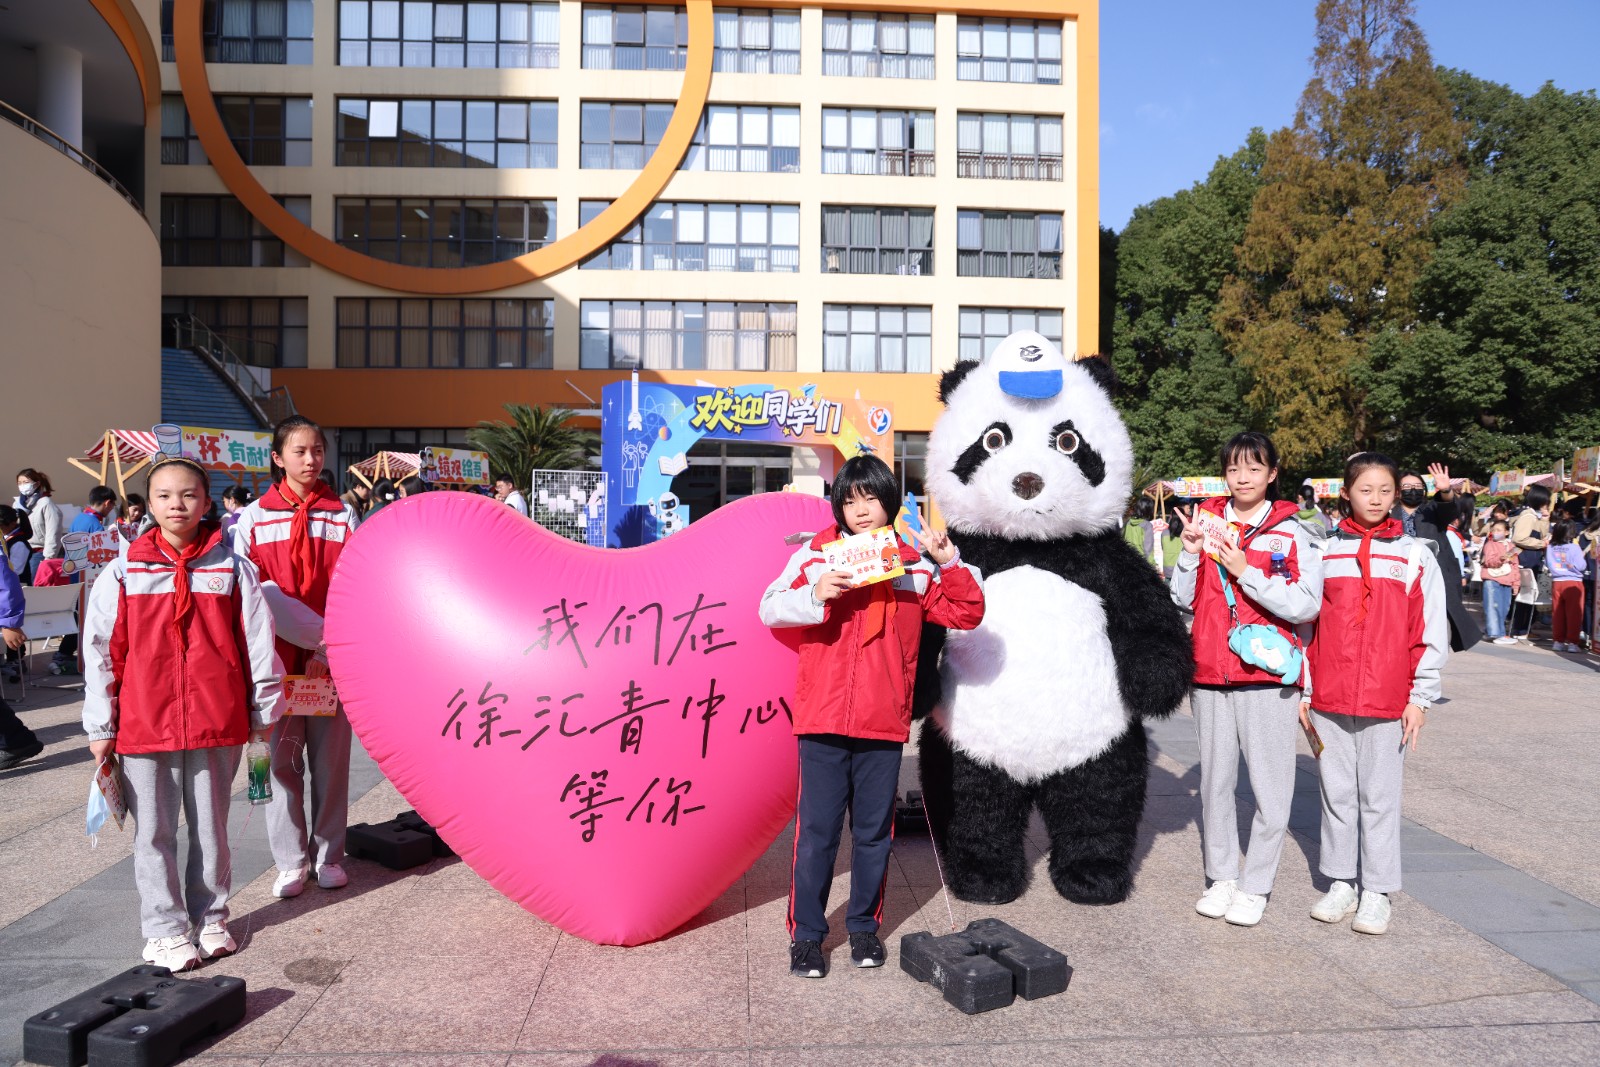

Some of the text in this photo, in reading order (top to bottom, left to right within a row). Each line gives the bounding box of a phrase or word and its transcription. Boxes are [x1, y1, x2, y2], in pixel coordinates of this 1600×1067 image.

[691, 389, 843, 435] 欢迎同学们
[523, 593, 737, 668] 我们在
[441, 680, 793, 758] 徐汇青中心
[559, 769, 705, 842] 等你
